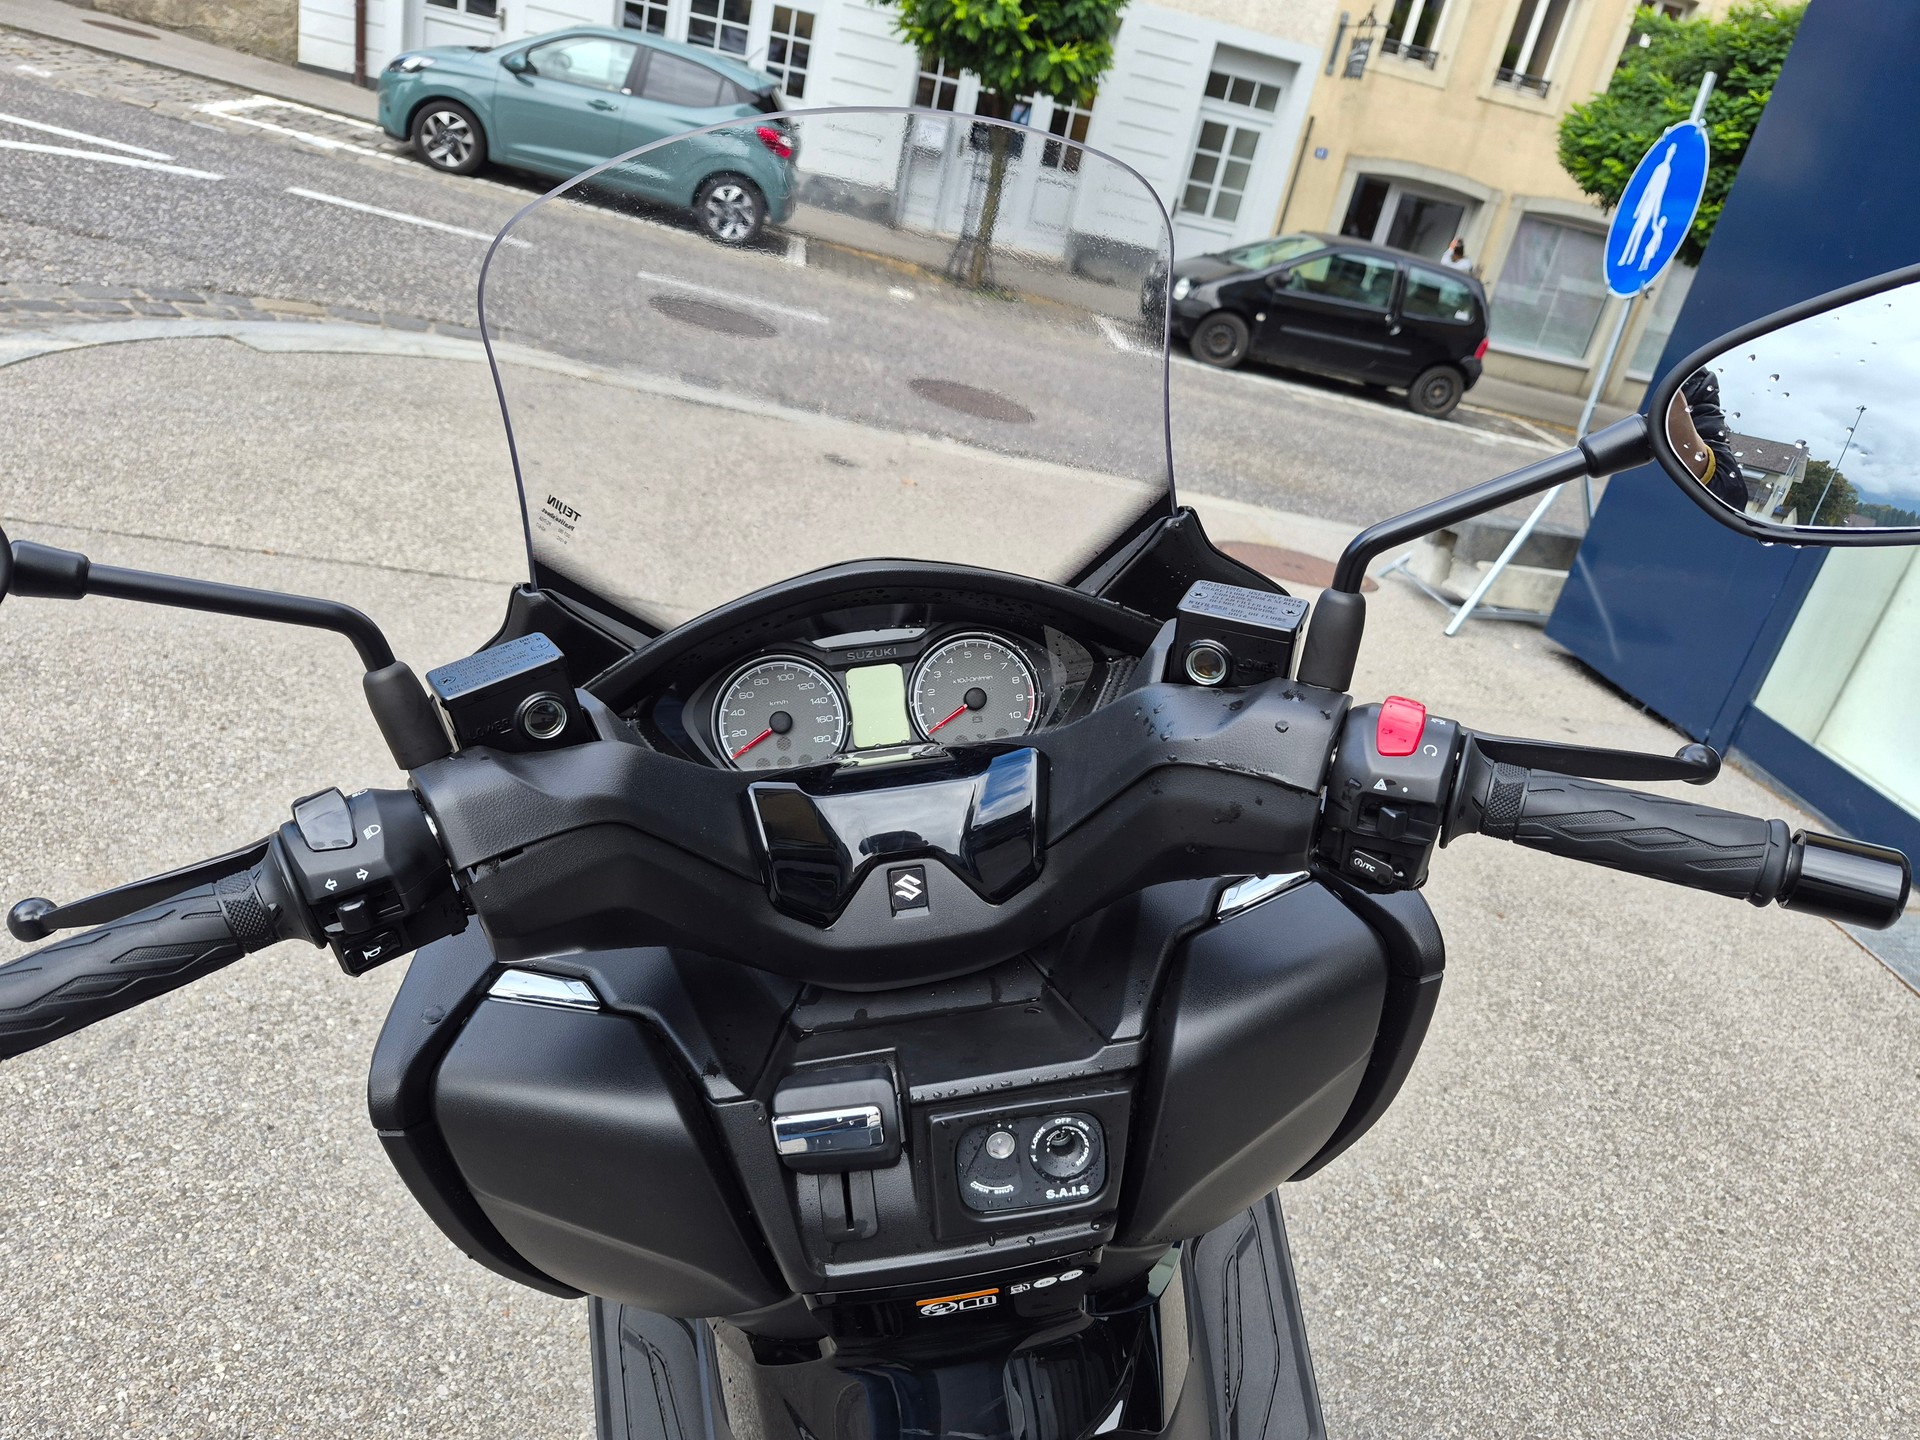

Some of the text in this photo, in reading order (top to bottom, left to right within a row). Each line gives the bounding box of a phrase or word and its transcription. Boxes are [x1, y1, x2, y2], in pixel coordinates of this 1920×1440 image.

[846, 647, 897, 661] SUZUKI
[1000, 662, 1008, 670] 7
[777, 673, 795, 681] 100
[933, 670, 941, 679] 3
[754, 678, 769, 686] 80
[1012, 676, 1020, 684] 8
[797, 682, 815, 690] 120
[738, 691, 754, 700] 60
[927, 688, 936, 696] 2
[810, 697, 828, 705] 140
[1015, 693, 1023, 702] 9
[730, 708, 745, 716] 40
[1008, 711, 1021, 719] 10
[816, 714, 834, 723] 160
[731, 729, 747, 738] 20
[813, 735, 831, 743] 180
[1077, 1120, 1090, 1132] ON
[1031, 1126, 1046, 1149] LOCK
[1075, 1147, 1090, 1167] OPEN
[970, 1181, 1015, 1195] OPEN SHUT
[1045, 1184, 1090, 1199] S.A.I.S
